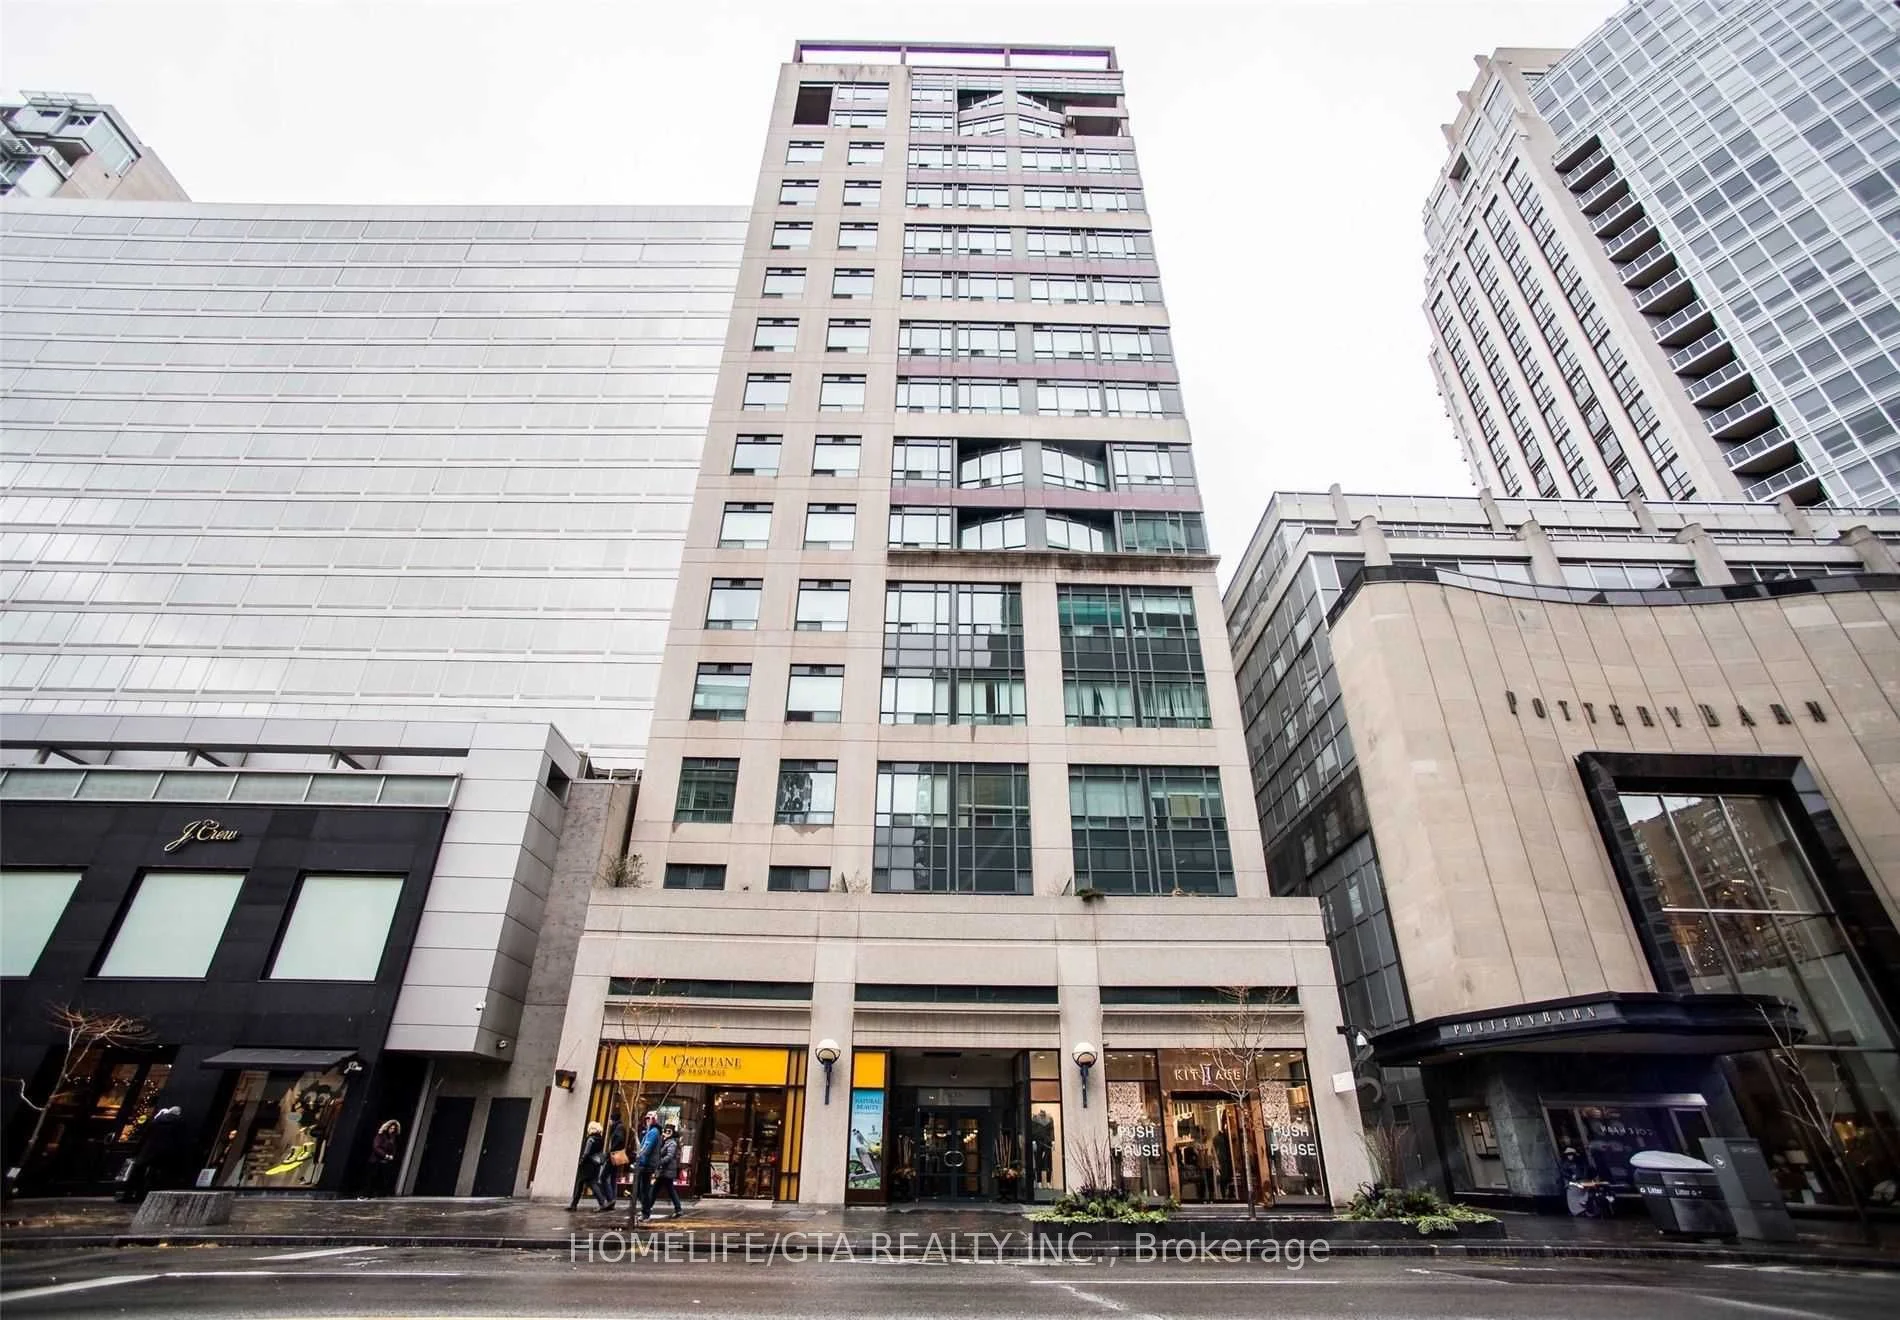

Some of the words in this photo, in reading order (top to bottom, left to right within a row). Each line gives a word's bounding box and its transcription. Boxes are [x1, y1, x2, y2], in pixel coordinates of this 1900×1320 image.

[1117, 1126, 1154, 1138] PUSH
[1273, 1125, 1309, 1137] PUSH
[1114, 1144, 1160, 1157] PAUSE
[1270, 1143, 1316, 1156] PAUSE
